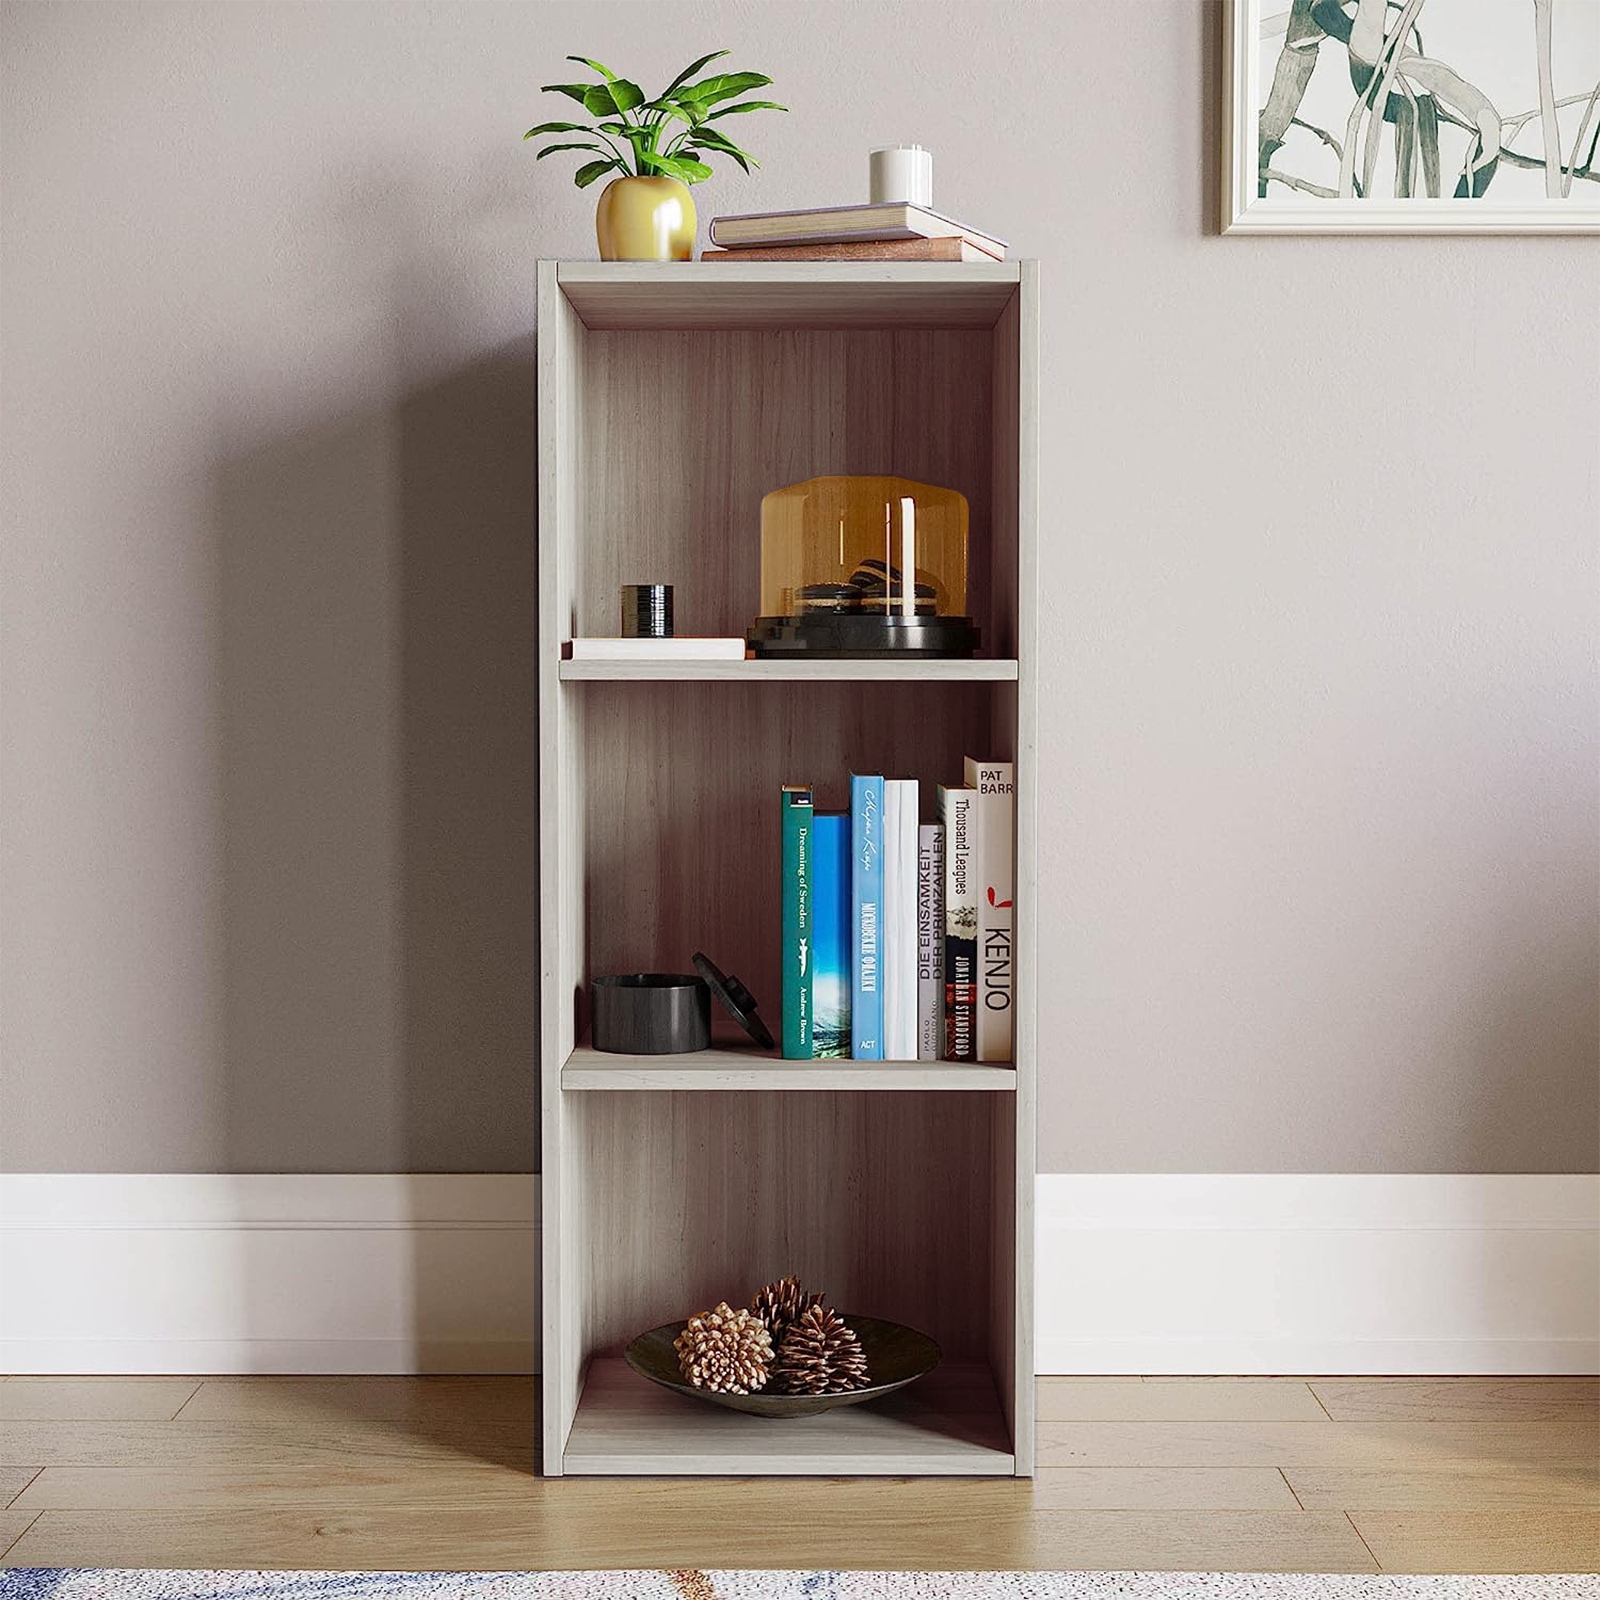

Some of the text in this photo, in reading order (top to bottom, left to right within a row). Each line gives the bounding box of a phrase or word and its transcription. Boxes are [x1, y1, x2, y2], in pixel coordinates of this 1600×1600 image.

[980, 770, 1002, 781] PAT
[980, 783, 1013, 794] BARR
[798, 827, 808, 928] Dreaming of Sweden
[952, 799, 970, 895] Thousand Leagues
[919, 846, 930, 980] DIE EINSAMKEIT
[933, 832, 943, 980] DER PRIMZAHLEN
[800, 986, 808, 1018] Andrew
[955, 956, 970, 1056] JONATHAN STANDFORD
[984, 928, 1010, 1011] KENJO
